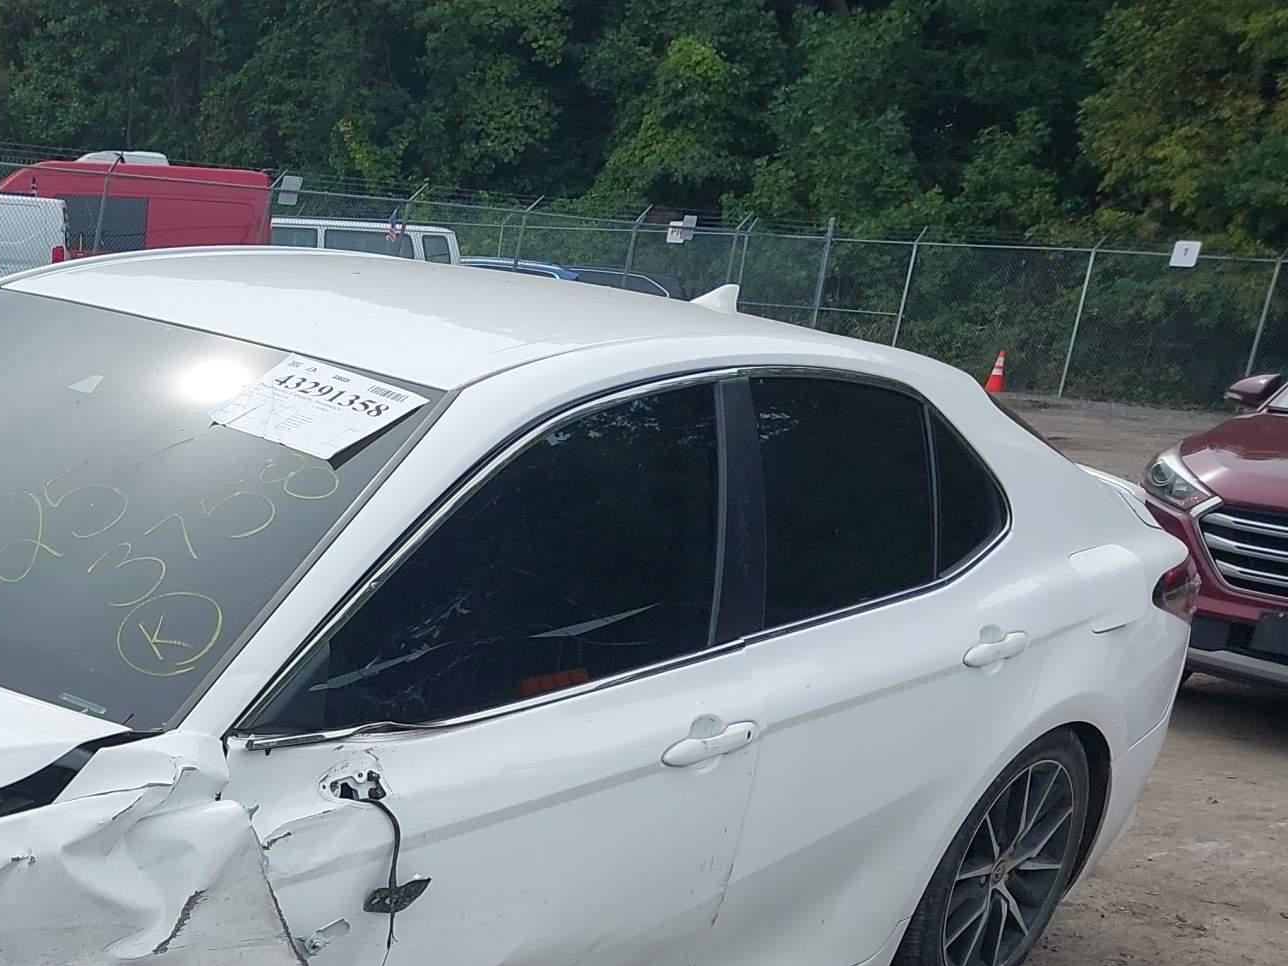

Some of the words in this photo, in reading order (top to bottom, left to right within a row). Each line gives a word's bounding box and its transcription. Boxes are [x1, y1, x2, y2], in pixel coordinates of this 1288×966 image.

[1183, 247, 1189, 256] 1
[275, 374, 391, 418] 43291358
[139, 612, 192, 660] K
